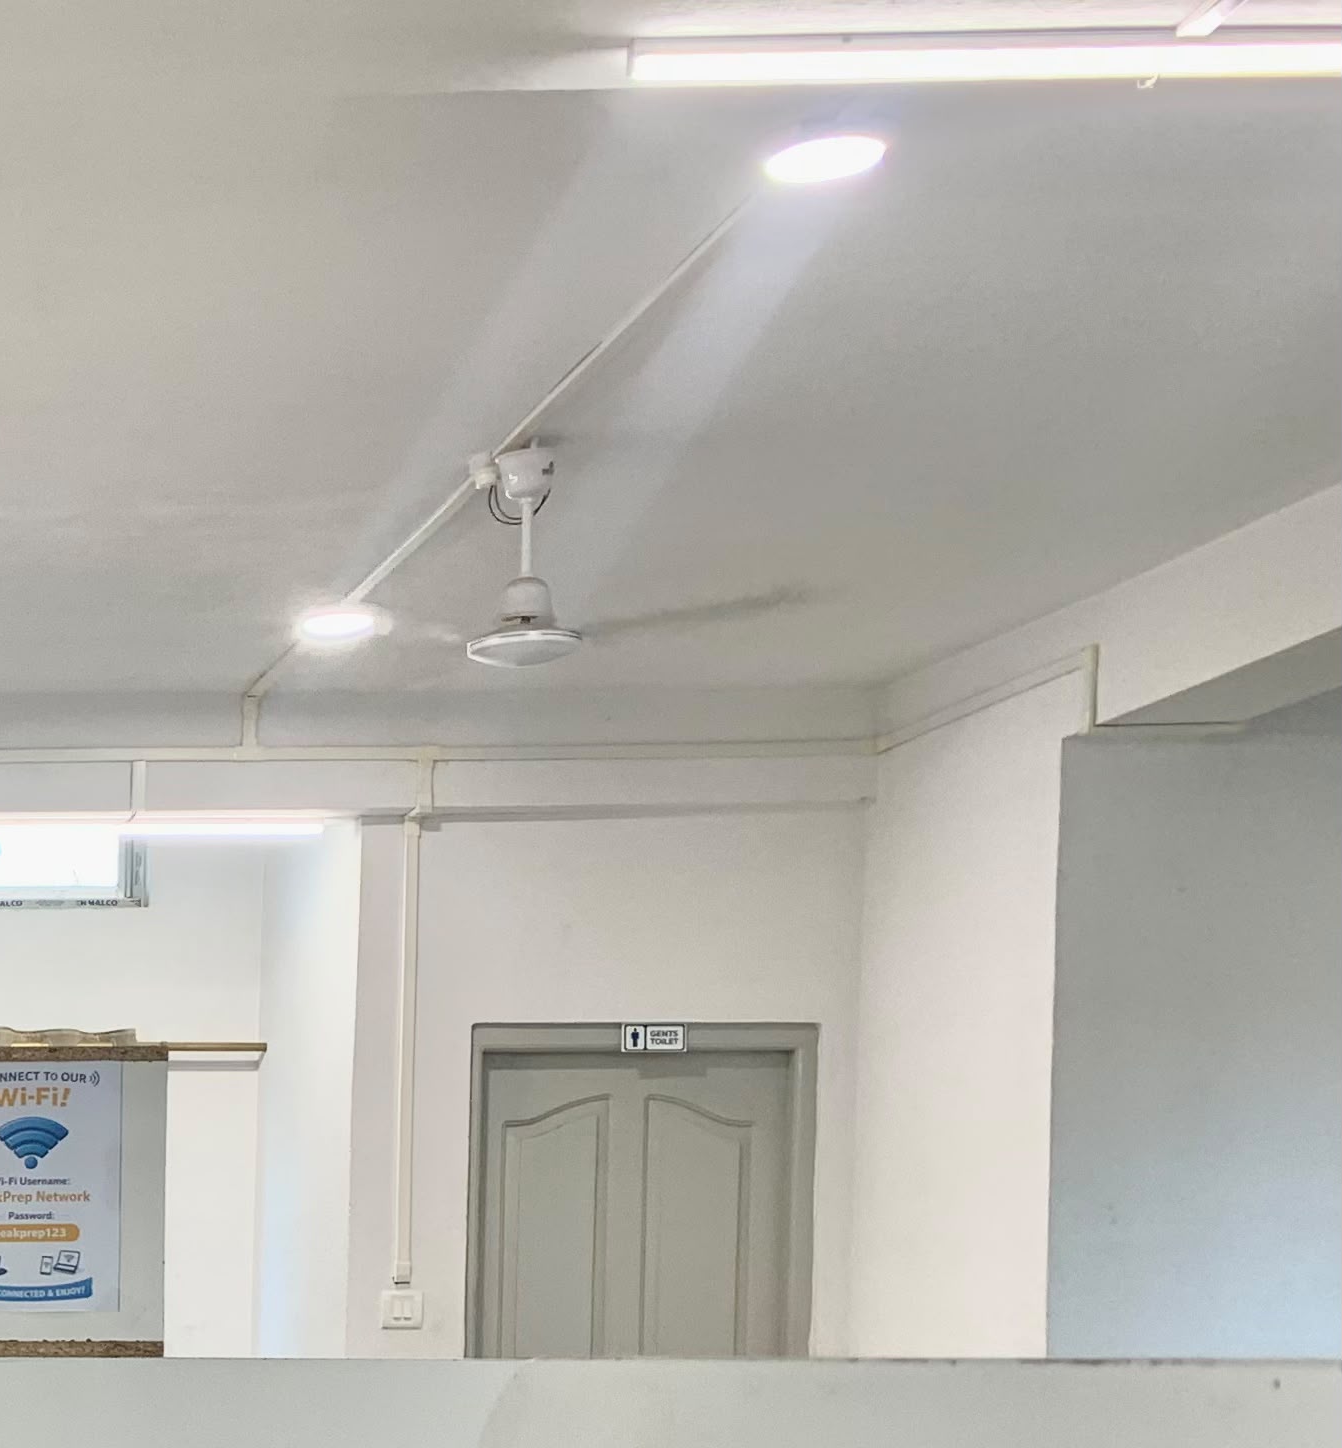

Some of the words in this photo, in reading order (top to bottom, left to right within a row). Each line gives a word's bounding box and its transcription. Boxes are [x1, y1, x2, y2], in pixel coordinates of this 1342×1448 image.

[60, 1073, 87, 1083] OUR
[20, 1177, 70, 1186] Username:
[37, 1191, 90, 1202] Network
[8, 1211, 55, 1221] Password:
